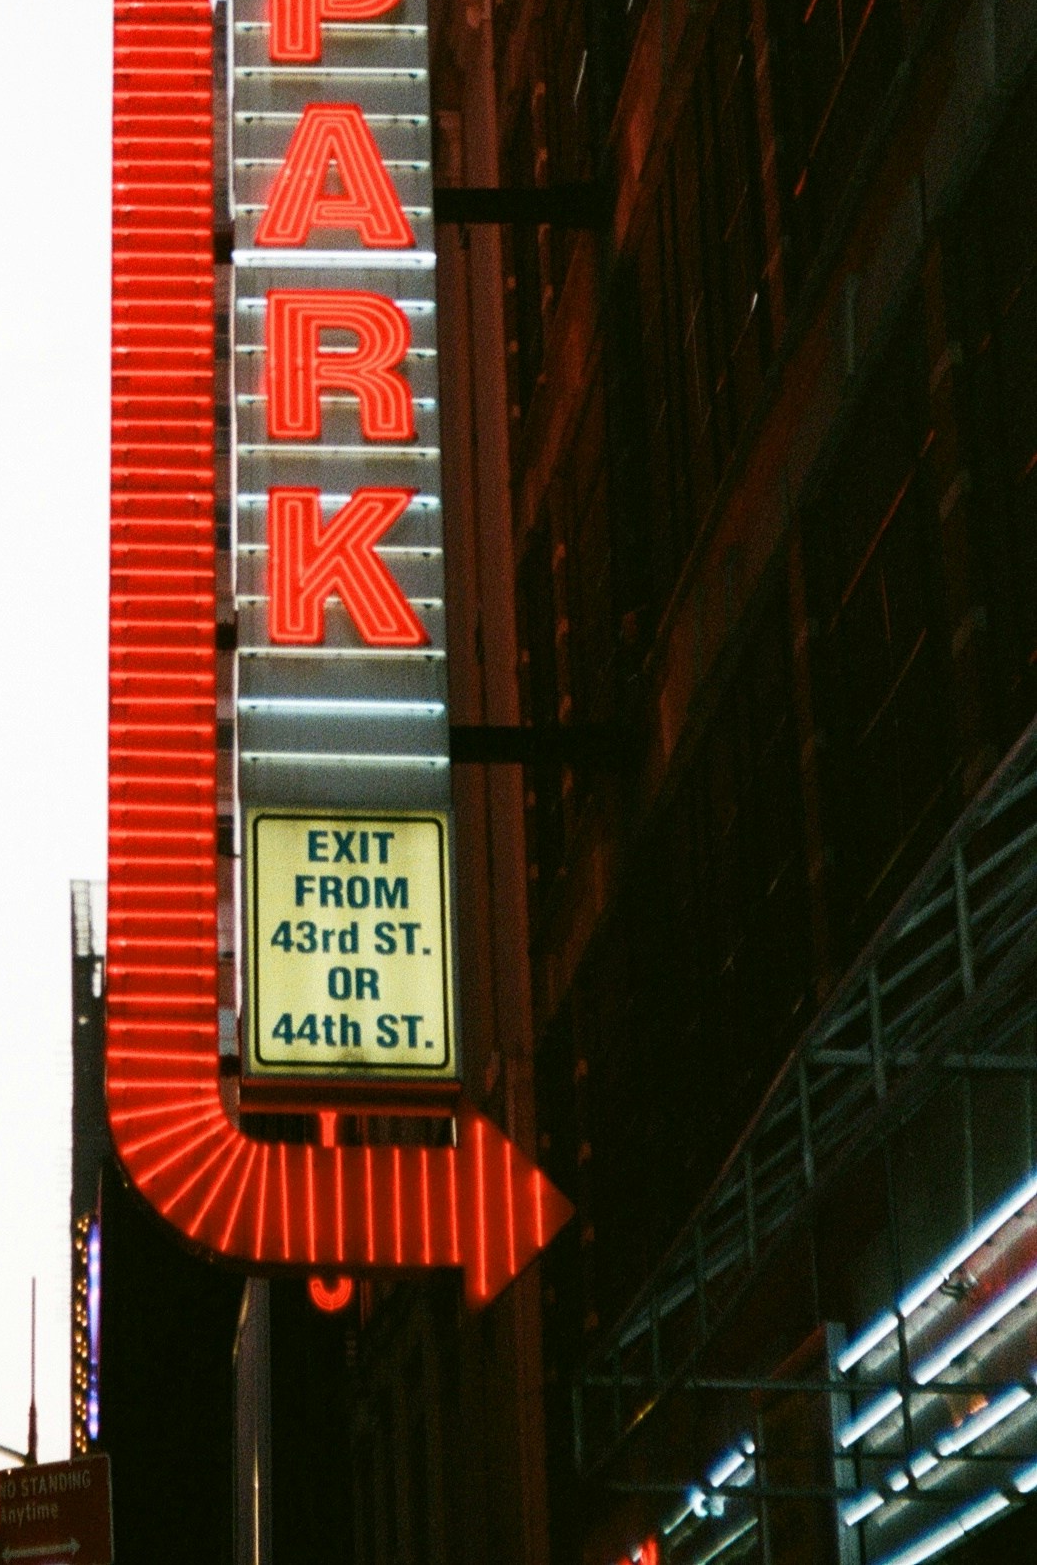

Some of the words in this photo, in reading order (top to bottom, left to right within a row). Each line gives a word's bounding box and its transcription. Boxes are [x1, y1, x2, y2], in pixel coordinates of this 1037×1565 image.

[307, 829, 396, 865] EXIT
[294, 873, 410, 910] FROM
[270, 920, 360, 955] 43rd
[373, 921, 432, 956] ST.
[327, 965, 380, 1001] OR
[271, 1012, 363, 1048] 44th
[375, 1013, 435, 1049] ST.
[0, 1479, 17, 1500] NO
[20, 1469, 92, 1499] STANDING
